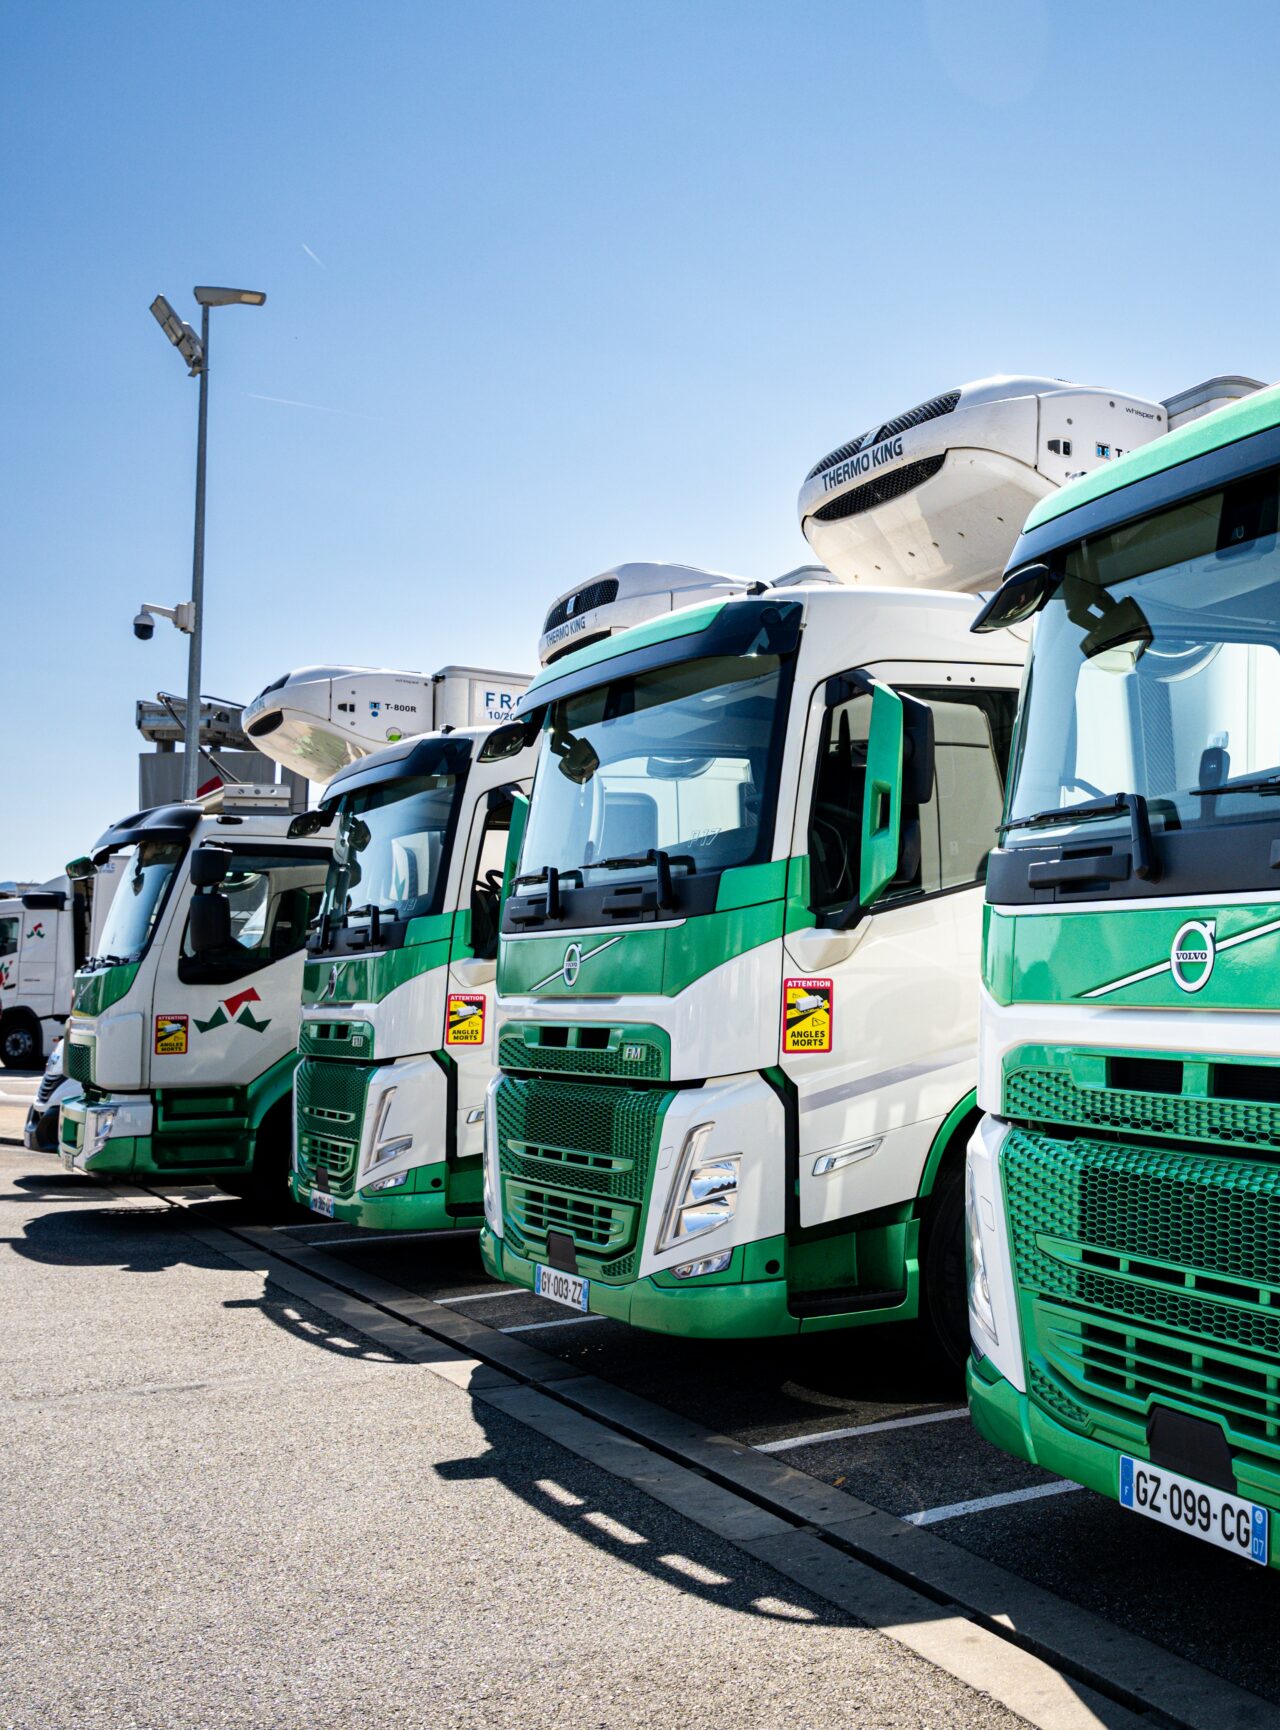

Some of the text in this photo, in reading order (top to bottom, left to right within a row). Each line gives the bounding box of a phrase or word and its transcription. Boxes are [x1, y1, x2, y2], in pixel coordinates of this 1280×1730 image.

[1125, 407, 1155, 420] whisper
[821, 437, 904, 491] THERMO KING
[546, 616, 586, 647] THERMO KING
[385, 703, 417, 713] T-800R
[488, 711, 515, 721] 10/20
[1175, 952, 1208, 961] VOLVO
[791, 1030, 826, 1039] ANGLES
[792, 1039, 824, 1047] MORTS
[1135, 1470, 1251, 1549] GZ-099-CG
[1252, 1537, 1264, 1557] 07
